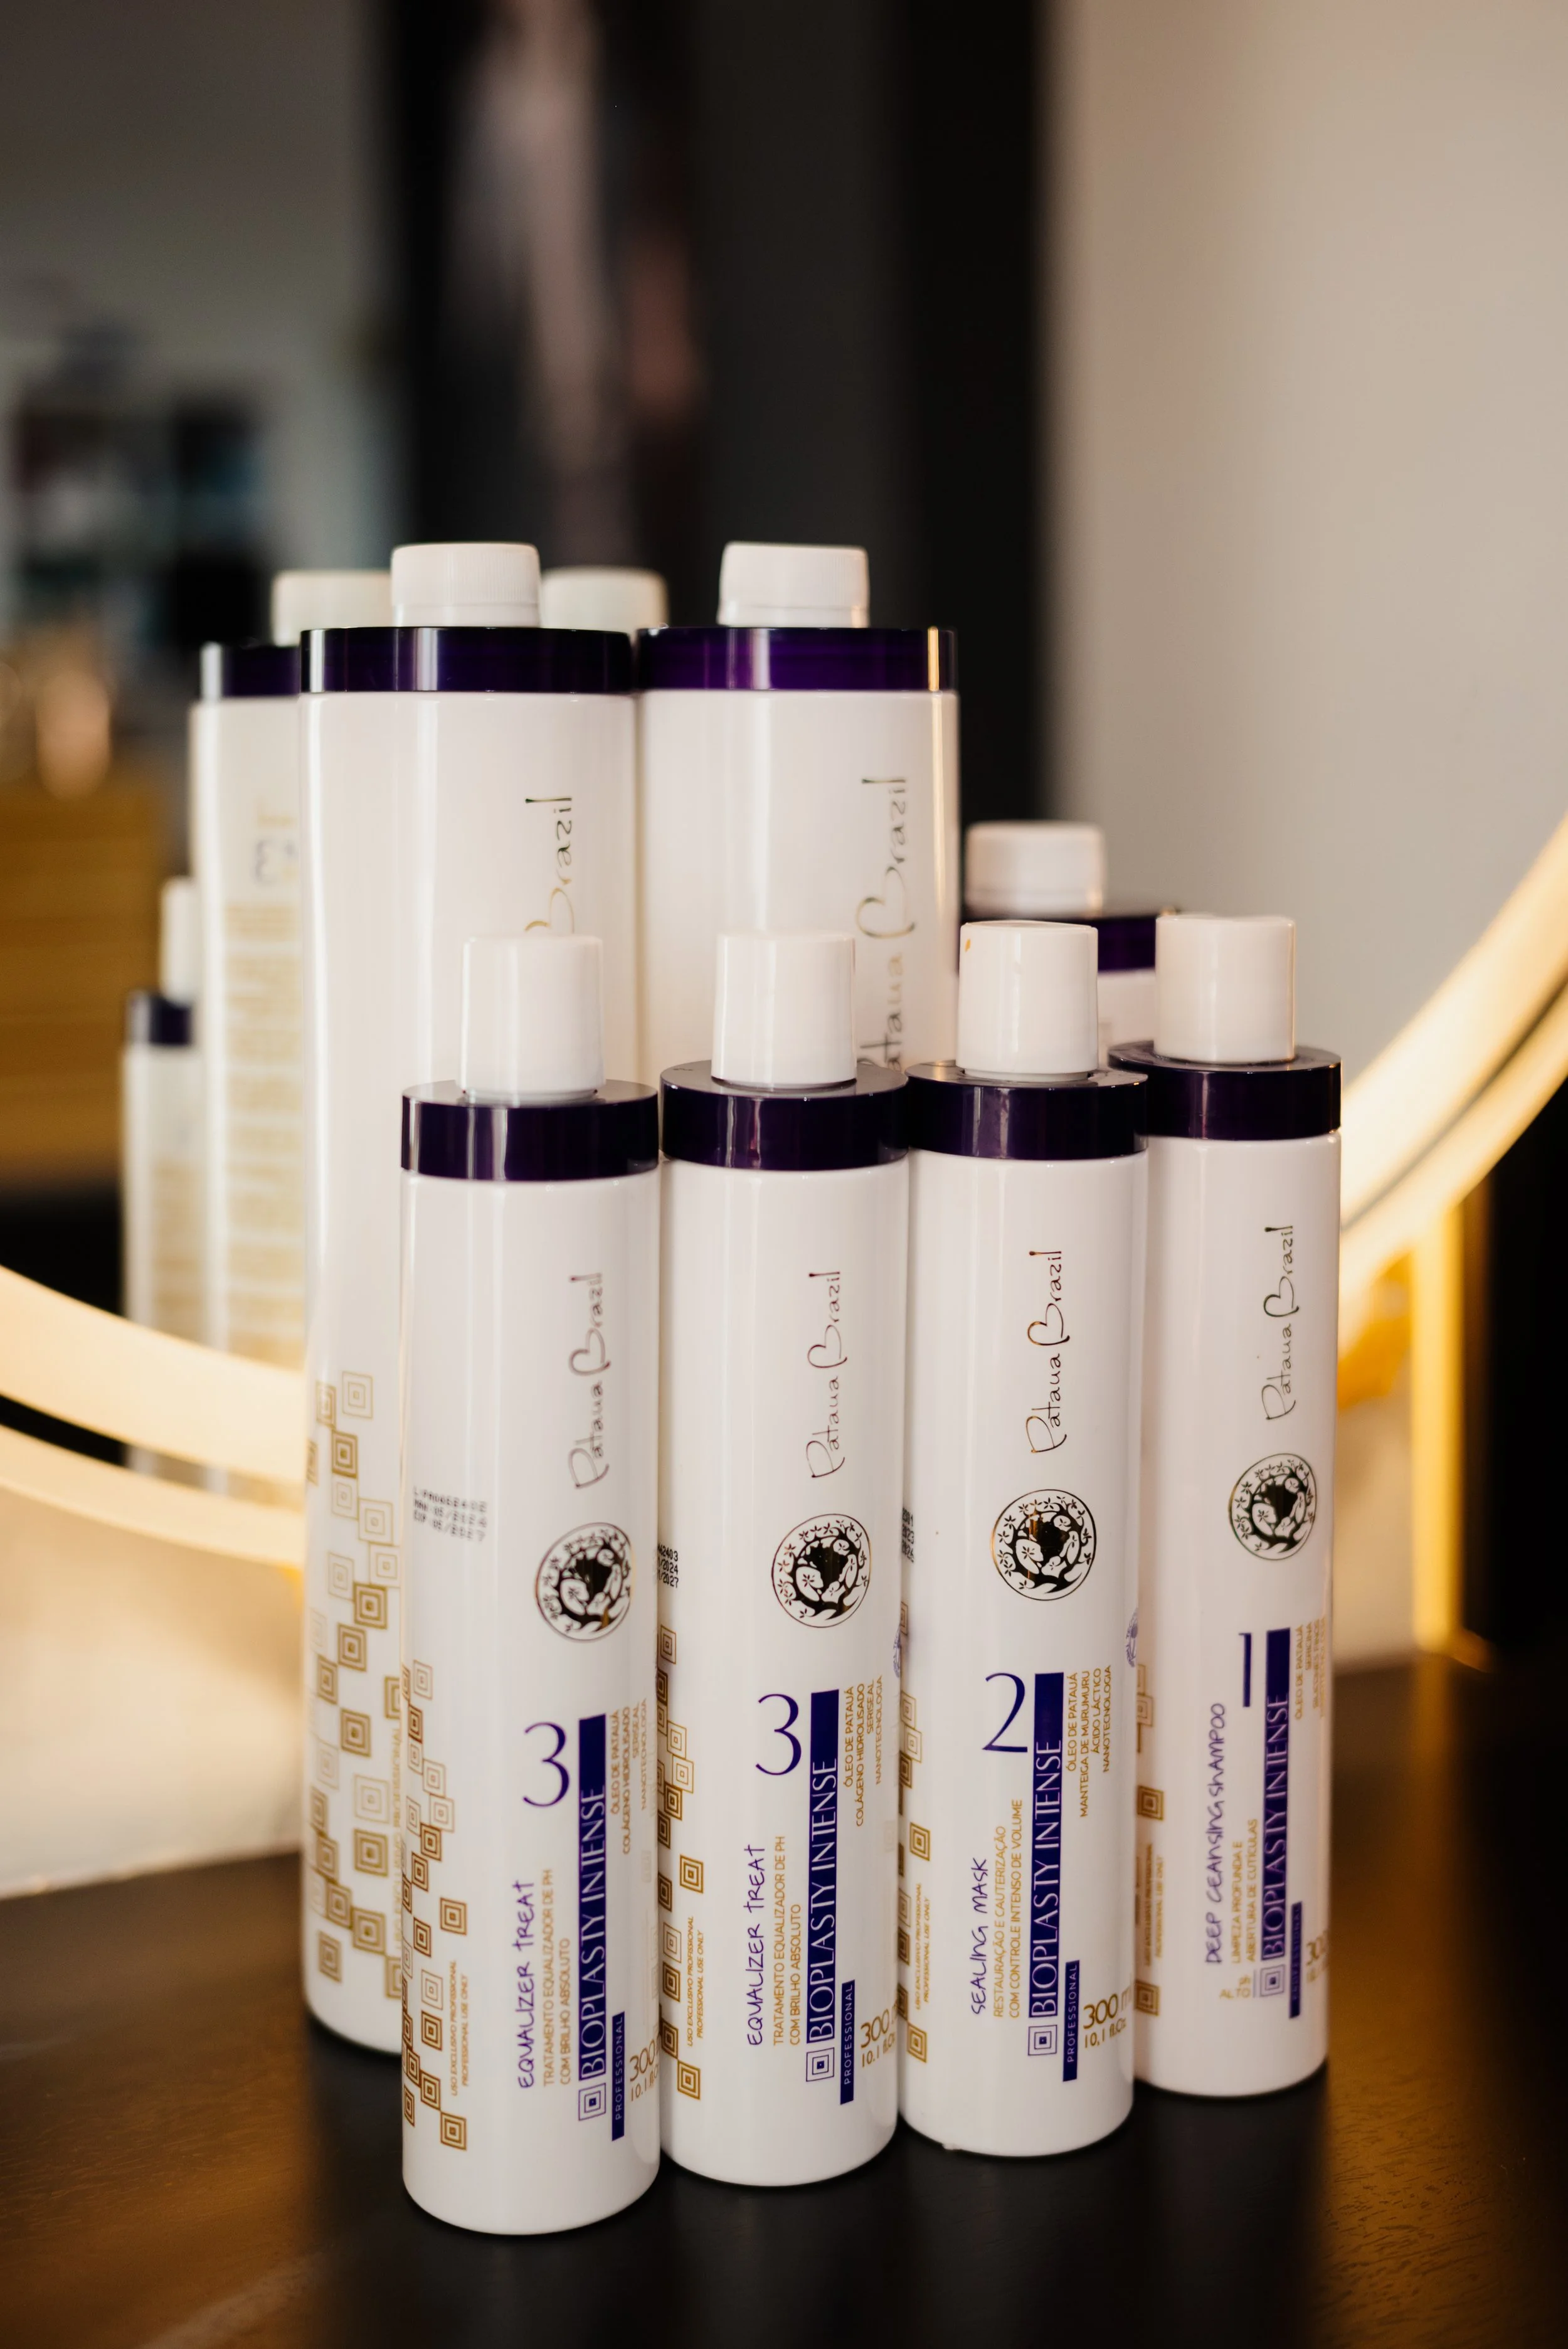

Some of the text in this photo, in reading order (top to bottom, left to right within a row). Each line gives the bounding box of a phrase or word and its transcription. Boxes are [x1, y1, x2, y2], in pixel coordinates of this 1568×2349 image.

[856, 777, 916, 1074] ataua Brazil
[567, 1271, 612, 1376] Brazil
[806, 1270, 848, 1478] Pataua Brazil
[1025, 1249, 1071, 1453] Pataua Brazil
[1261, 1224, 1300, 1419] Pataua Brazil
[981, 1672, 1029, 1752] 2
[1066, 1672, 1078, 1772] ÓLEO DE PATAUÁ
[1091, 1667, 1102, 1753] ÁCIDO LÁCTICO
[1103, 1664, 1112, 1773] NANOTECNOLOGIA
[1237, 1632, 1253, 1707] 1
[522, 1721, 569, 1806] 3
[612, 1761, 620, 1777] DE
[755, 1693, 802, 1775] 3
[843, 1685, 854, 1787] ÓLEO DE PATAUÁ
[855, 1682, 865, 1826] COLÁGENO HIDROLISADO
[1079, 1670, 1090, 1817] MANTEIGA DE MURUMURU
[1207, 1702, 1226, 1796] SHAMPOO
[993, 1825, 1009, 1917] CAUTERIZAÇÃO
[1030, 1738, 1062, 2017] BIOPLASTY INTENSE
[1263, 1692, 1289, 1958] BIOPLASTY INTENSE
[580, 1784, 605, 2079] BIOPLASTY INTENSE
[743, 1843, 765, 2045] EQUALIZER TREAT
[773, 1835, 786, 2045] TRATAMENTO EQUALIZADOR DE PH
[808, 1757, 837, 2041] BIOPLASTY INTENSE
[969, 1856, 989, 2014] SEALING MASK
[1009, 1798, 1023, 2018] COM CONTROLE INTENSO DE VOLUME
[1204, 1911, 1222, 1963] DEEP
[1231, 1840, 1242, 1963] LIMPEZA PROFUNDA E
[1246, 1818, 1258, 1962] ABERTURA DE CUTÍCULAS
[512, 1879, 534, 2088] EQUALIZER TREAT
[542, 1869, 554, 2086] TRATAMENTO EQUALIZADOR DE PH
[559, 1937, 571, 2085] COM BRILHO ABSOLUTO
[790, 1904, 801, 2045] COM BRILHO ABSOLUTO
[861, 2008, 889, 2049] 300
[992, 1930, 1007, 2017] RESTAURAÇÃO
[1066, 1963, 1078, 2062] PROFESSIONAL
[1083, 1993, 1118, 2029] 300
[614, 2016, 623, 2119] PROFESSIONAL
[844, 1983, 853, 2084] PROFESSIONAL
[862, 2044, 880, 2068] 10.1
